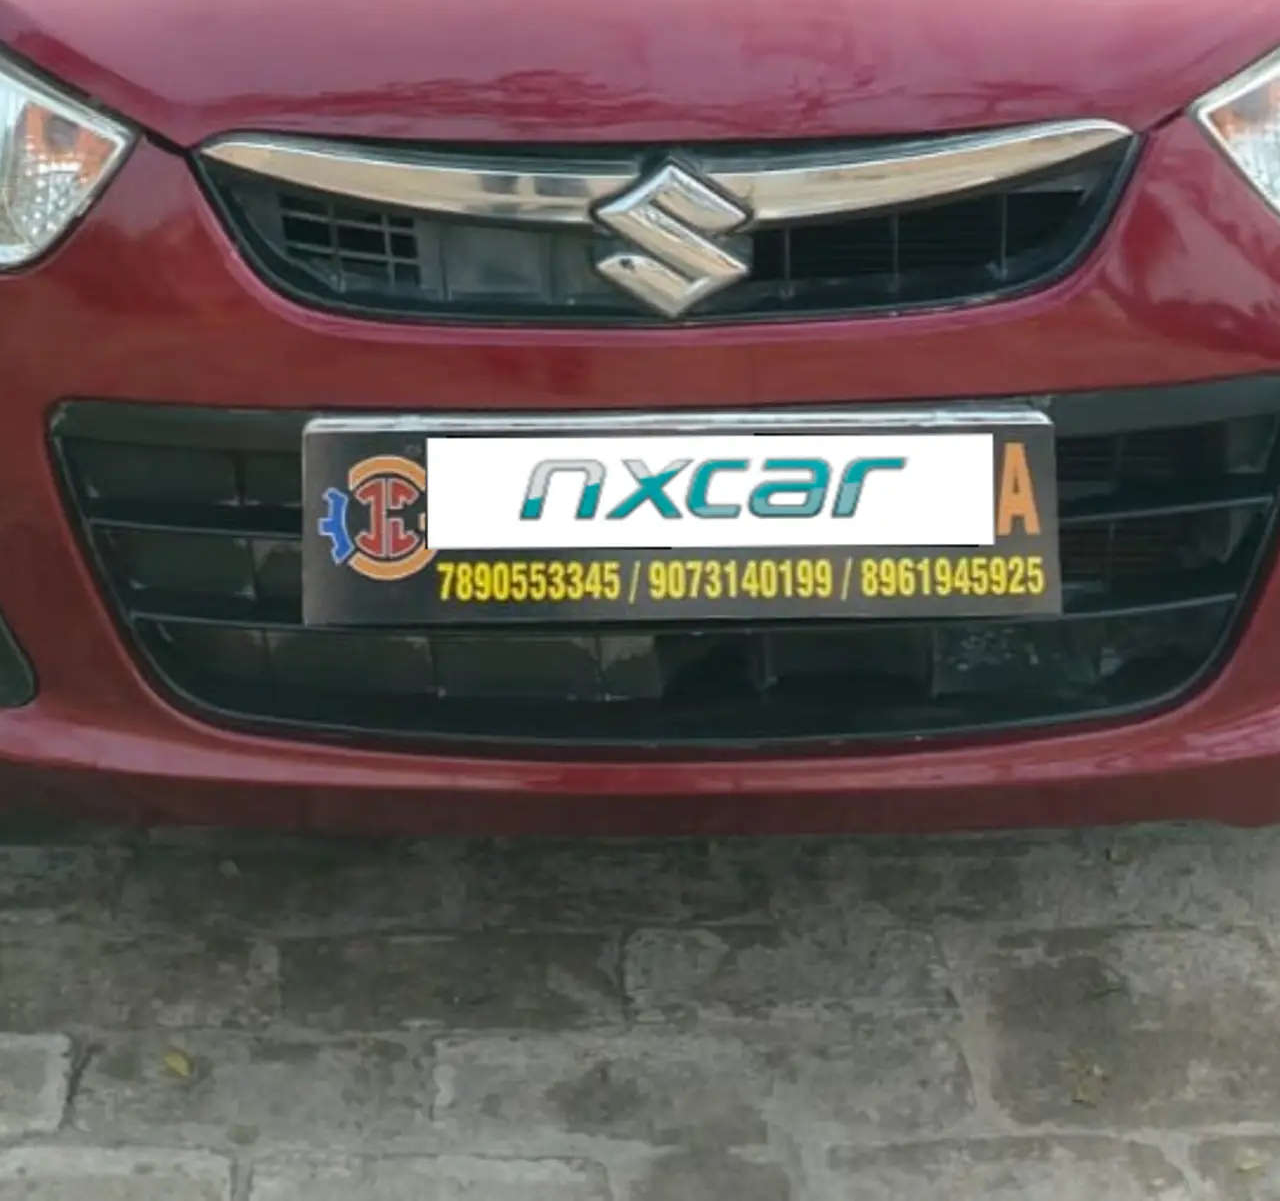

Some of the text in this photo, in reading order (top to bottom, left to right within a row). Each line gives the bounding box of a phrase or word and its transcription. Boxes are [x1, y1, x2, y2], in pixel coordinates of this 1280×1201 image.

[436, 560, 621, 601] 7890553345
[648, 558, 833, 600] 9073140199
[860, 555, 1045, 596] 8961945925
